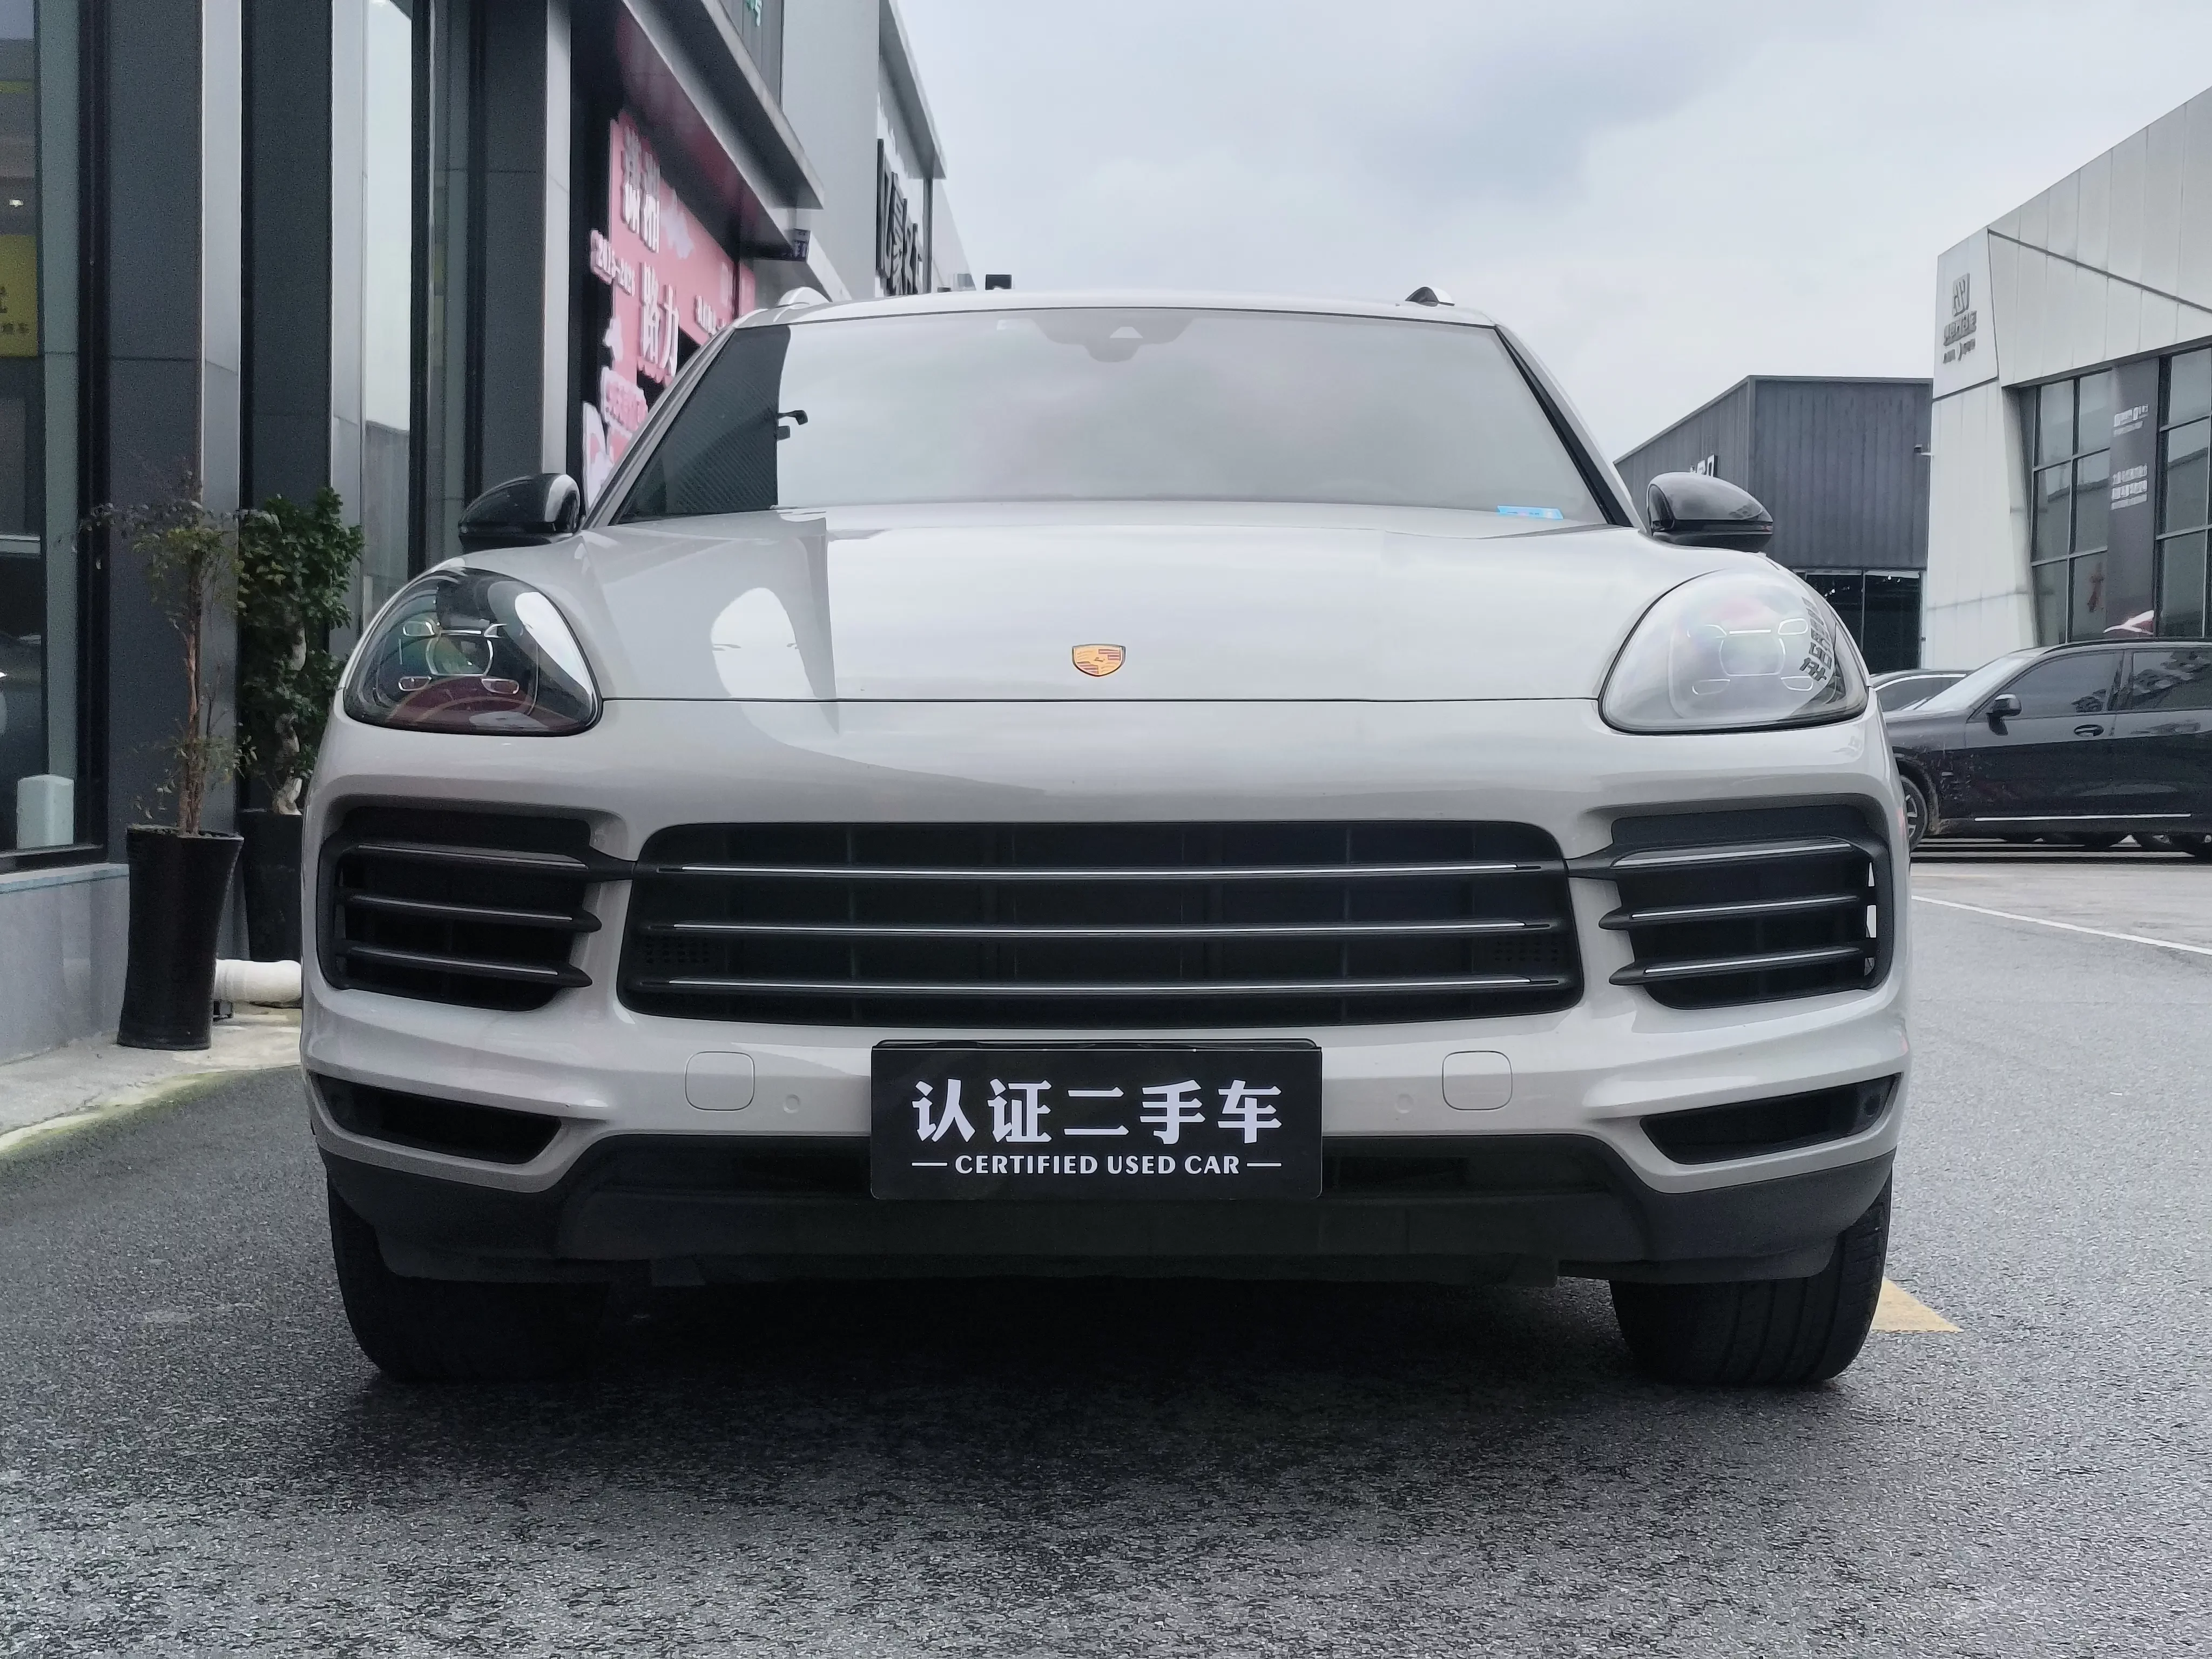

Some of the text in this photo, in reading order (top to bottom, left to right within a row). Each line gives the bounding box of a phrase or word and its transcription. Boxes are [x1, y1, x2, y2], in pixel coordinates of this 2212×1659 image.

[911, 1078, 1282, 1144] 认证二手车
[955, 1155, 1239, 1174] CERTIFIED USED CAR
